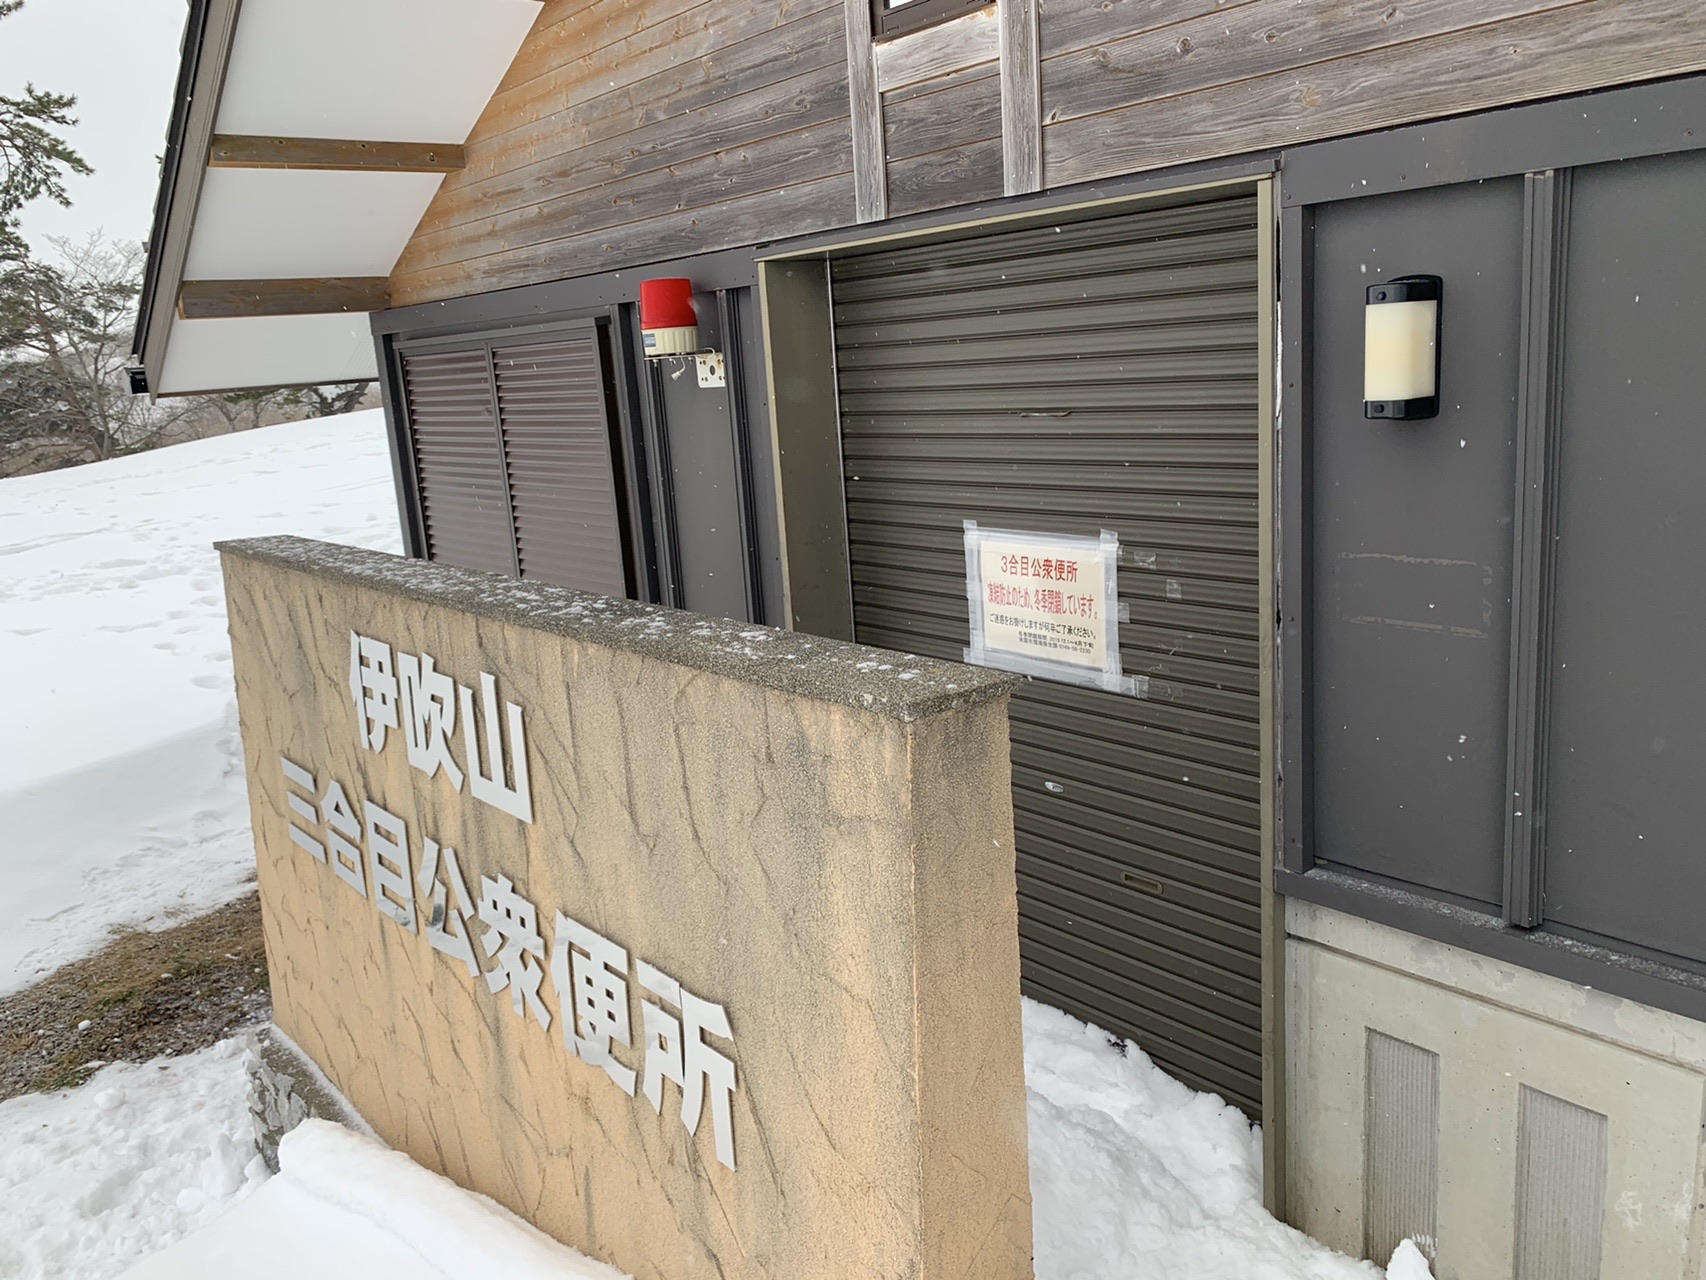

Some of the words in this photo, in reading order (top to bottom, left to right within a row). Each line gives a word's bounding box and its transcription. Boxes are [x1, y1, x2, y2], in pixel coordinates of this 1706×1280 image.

[1000, 554, 1078, 583] 3合目公衆便所
[349, 629, 535, 825] 伊吹山
[279, 756, 737, 1173] 三合目公衆便所
